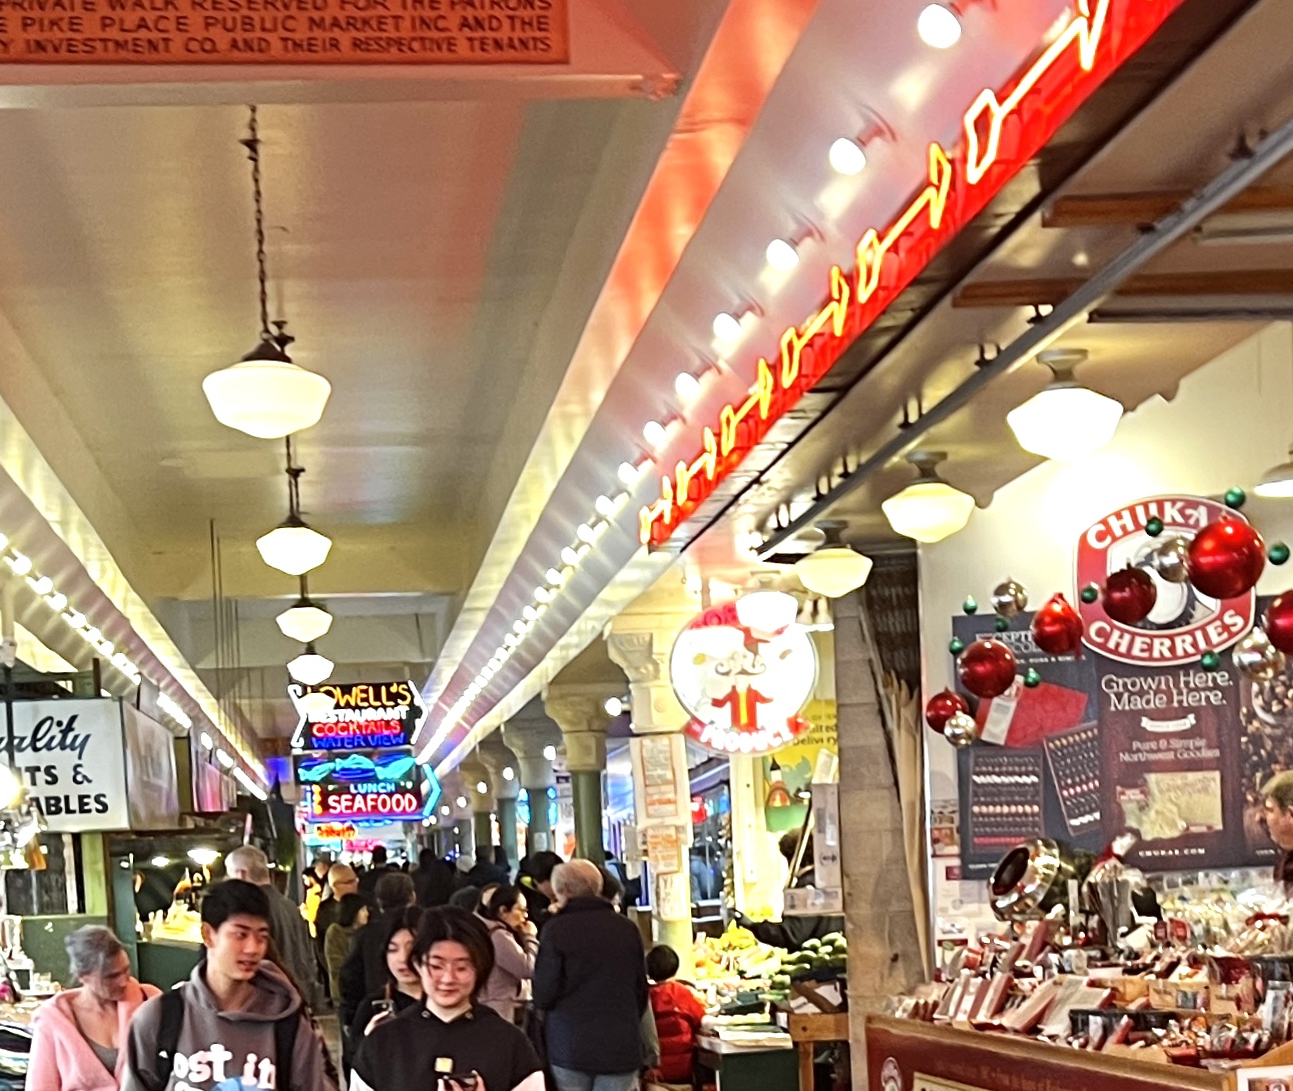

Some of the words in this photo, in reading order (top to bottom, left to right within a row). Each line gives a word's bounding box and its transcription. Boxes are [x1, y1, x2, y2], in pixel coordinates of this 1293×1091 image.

[21, 16, 84, 33] PIKE
[100, 16, 190, 33] PLACE
[205, 15, 298, 32] PUBLIC
[308, 15, 404, 32] MARKET
[458, 15, 503, 32] AND
[507, 15, 550, 32] THE
[25, 37, 174, 54] INVESTMENT
[229, 37, 271, 53] AND
[280, 36, 342, 53] THEIR
[351, 36, 458, 53] RESPECTIVE
[467, 36, 552, 53] TENANTS
[1086, 501, 1209, 549] CHUKA
[1088, 609, 1245, 658] CHERRIES
[1101, 674, 1174, 693] Grown
[1180, 669, 1233, 688] Here.
[1110, 691, 1167, 711] Made
[1172, 688, 1227, 707] Here.
[312, 720, 401, 737] COCKTAILS
[312, 736, 365, 748] WATER
[368, 733, 404, 746] VIEW
[72, 763, 93, 785] &
[349, 783, 395, 793] LUNCH
[328, 793, 418, 814] SEAFOOD
